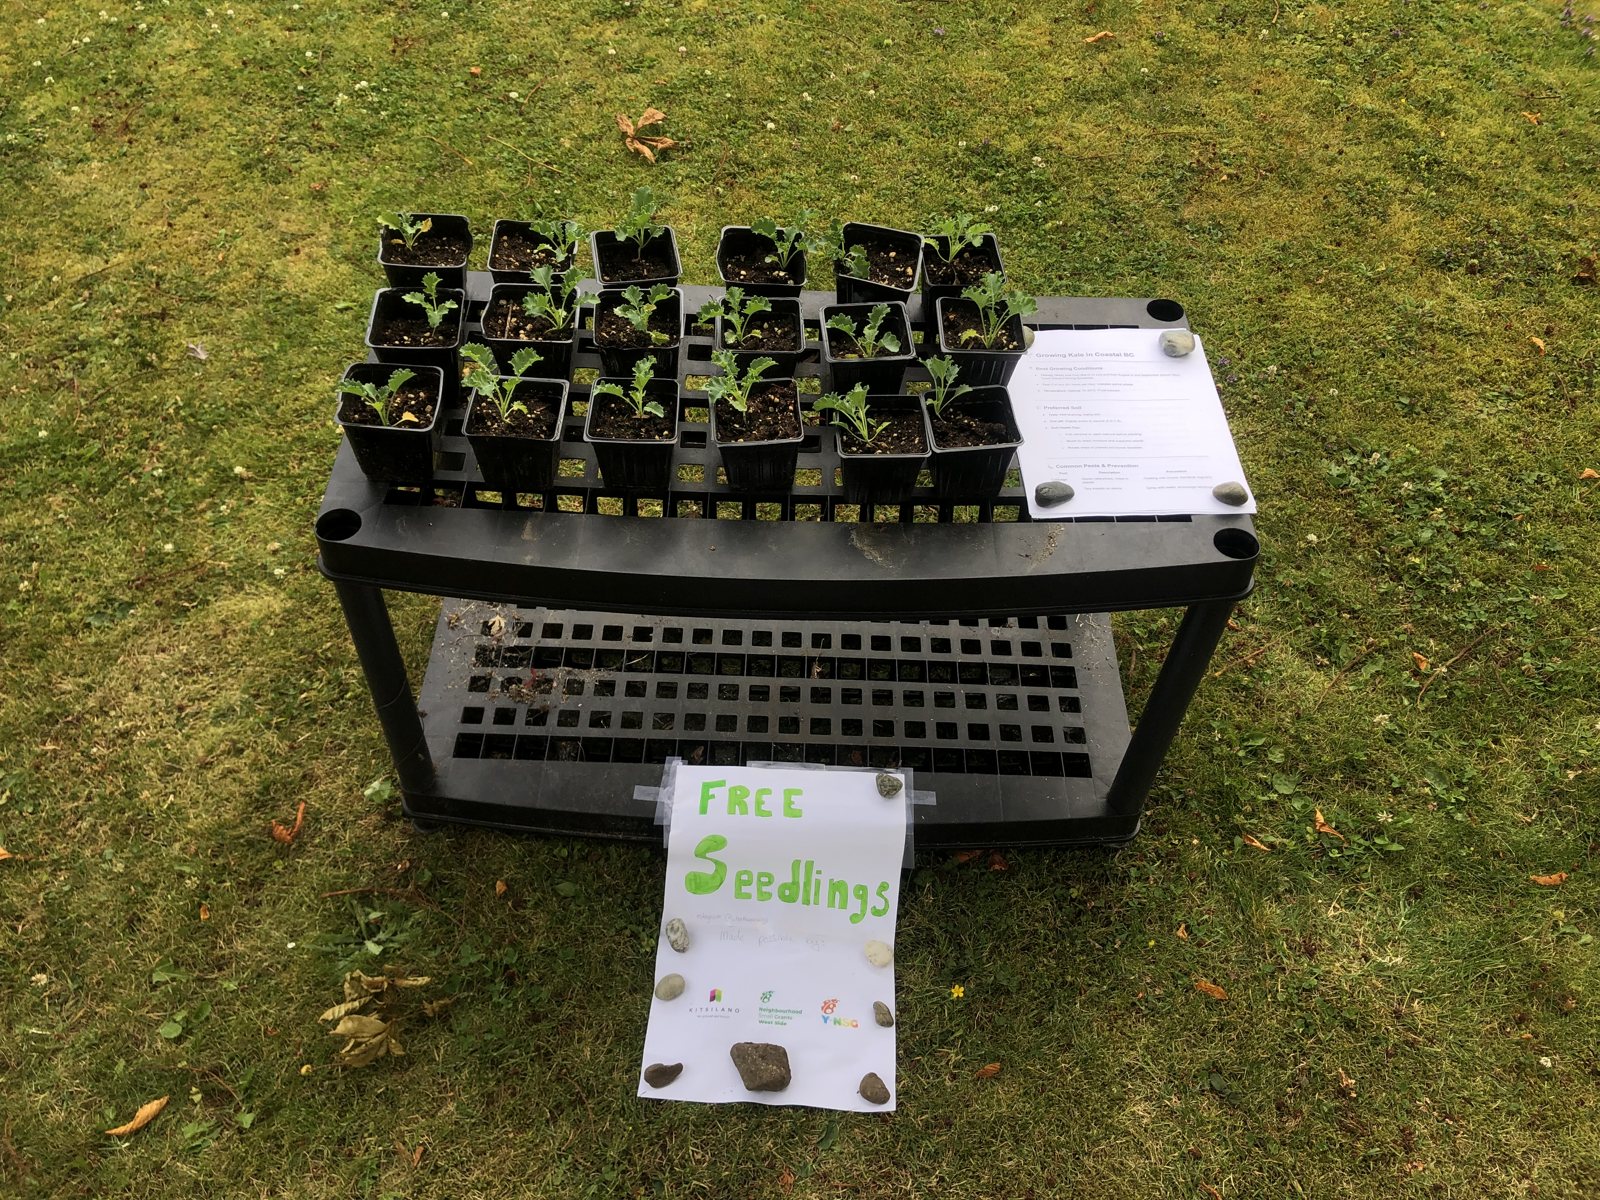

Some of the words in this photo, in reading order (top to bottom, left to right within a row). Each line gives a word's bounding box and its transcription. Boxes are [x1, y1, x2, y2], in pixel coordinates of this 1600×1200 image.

[699, 779, 803, 818] FREE
[685, 834, 889, 924] Seedlings
[758, 1007, 803, 1015] Neighbourhood
